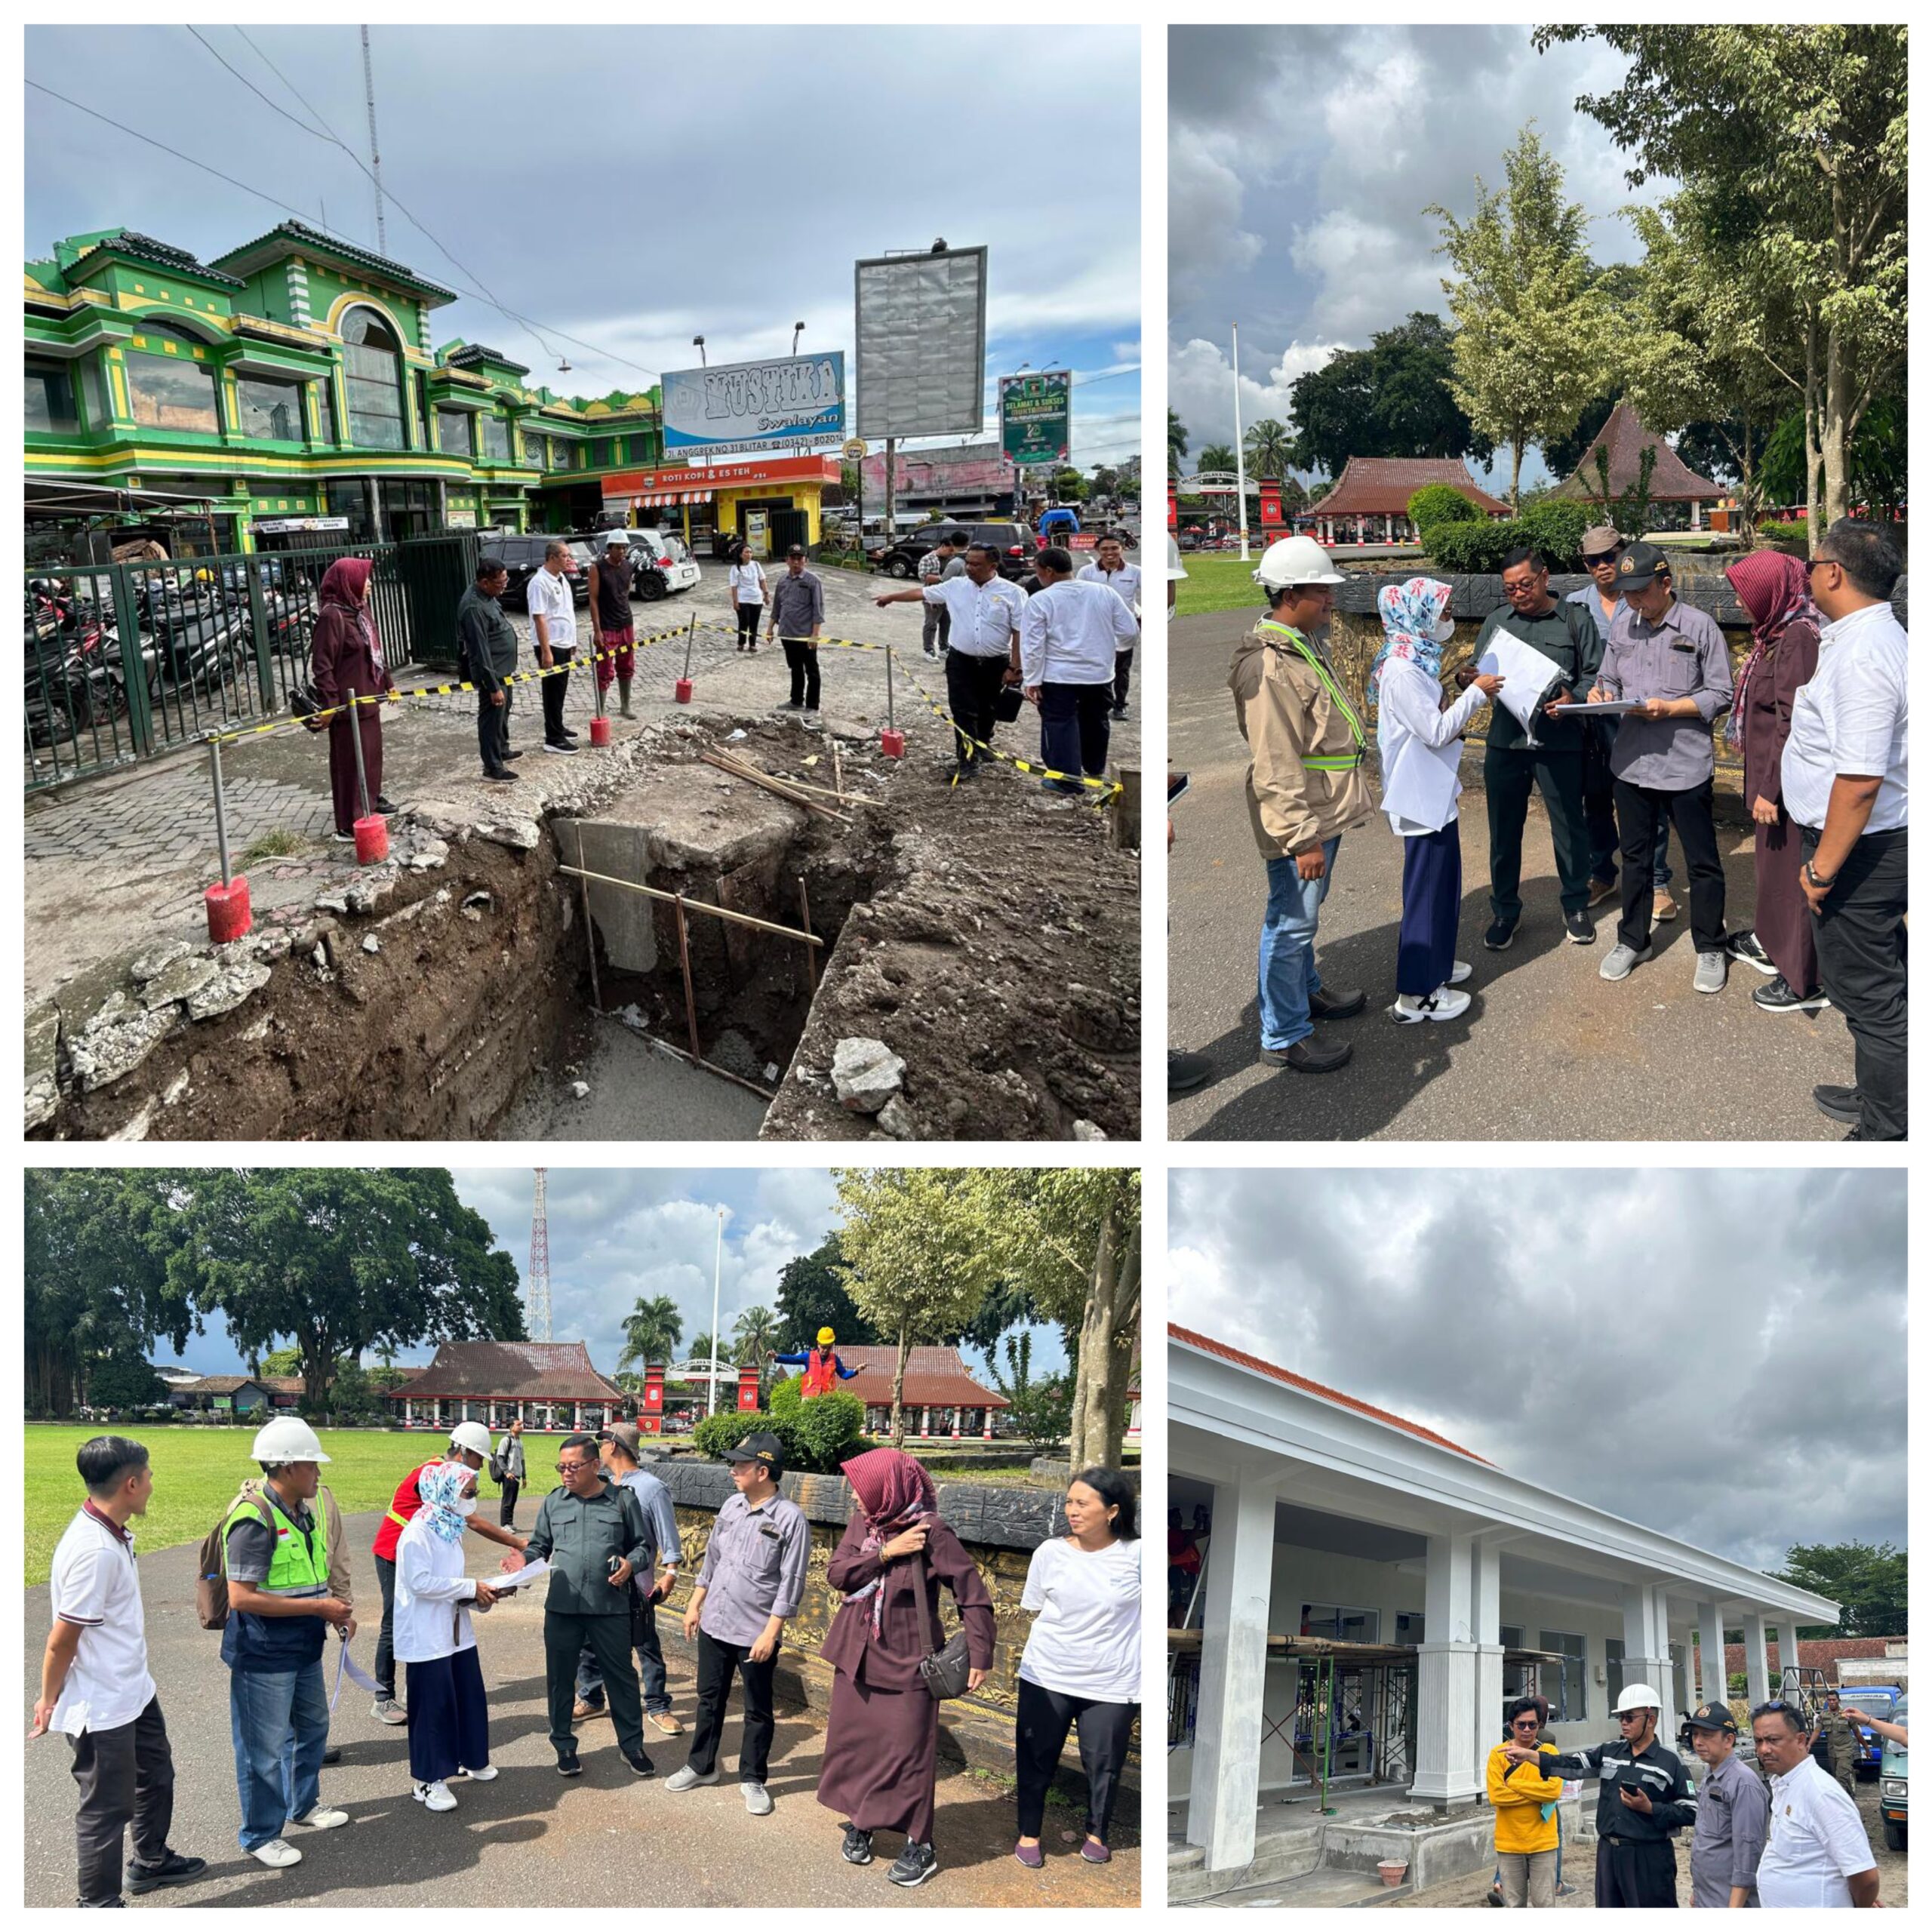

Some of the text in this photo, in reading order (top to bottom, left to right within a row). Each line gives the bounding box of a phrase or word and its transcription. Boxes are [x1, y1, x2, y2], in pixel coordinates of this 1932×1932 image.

[758, 414, 839, 431] Swalayan
[678, 447, 714, 457] ANGGREK
[739, 441, 768, 452] BLITAR
[707, 469, 715, 479] &
[718, 469, 731, 477] ES
[733, 467, 750, 475] TEH
[1181, 474, 1201, 485] SELAMAT
[669, 1361, 687, 1371] SELAMAT
